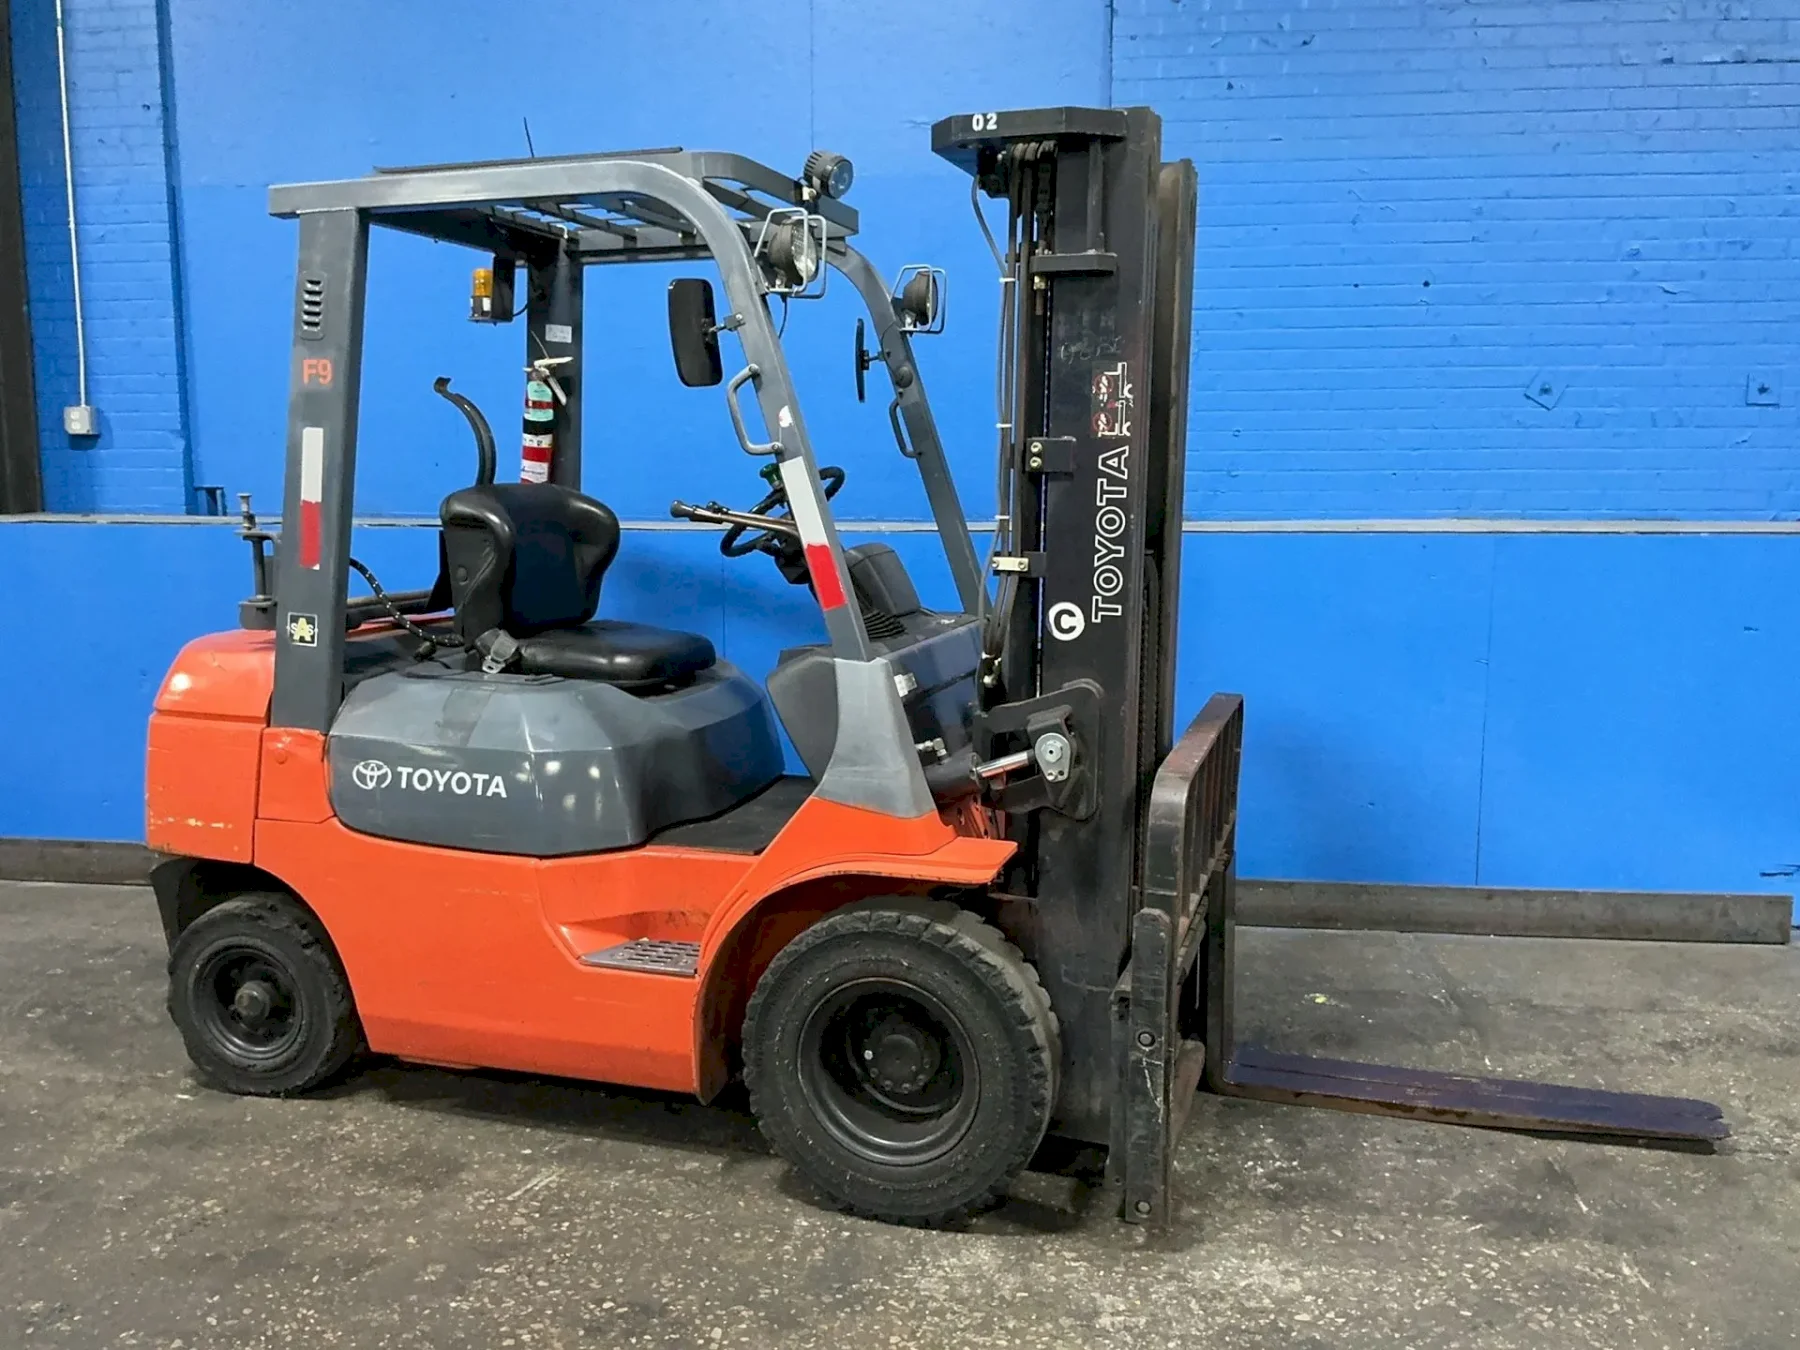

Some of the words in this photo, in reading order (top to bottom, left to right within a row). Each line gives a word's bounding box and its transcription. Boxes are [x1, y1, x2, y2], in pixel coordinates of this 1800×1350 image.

[972, 113, 998, 131] 02
[302, 359, 332, 384] F9
[1092, 445, 1130, 623] TOYOTA
[1053, 609, 1077, 634] C
[396, 766, 508, 798] TOYOTA
